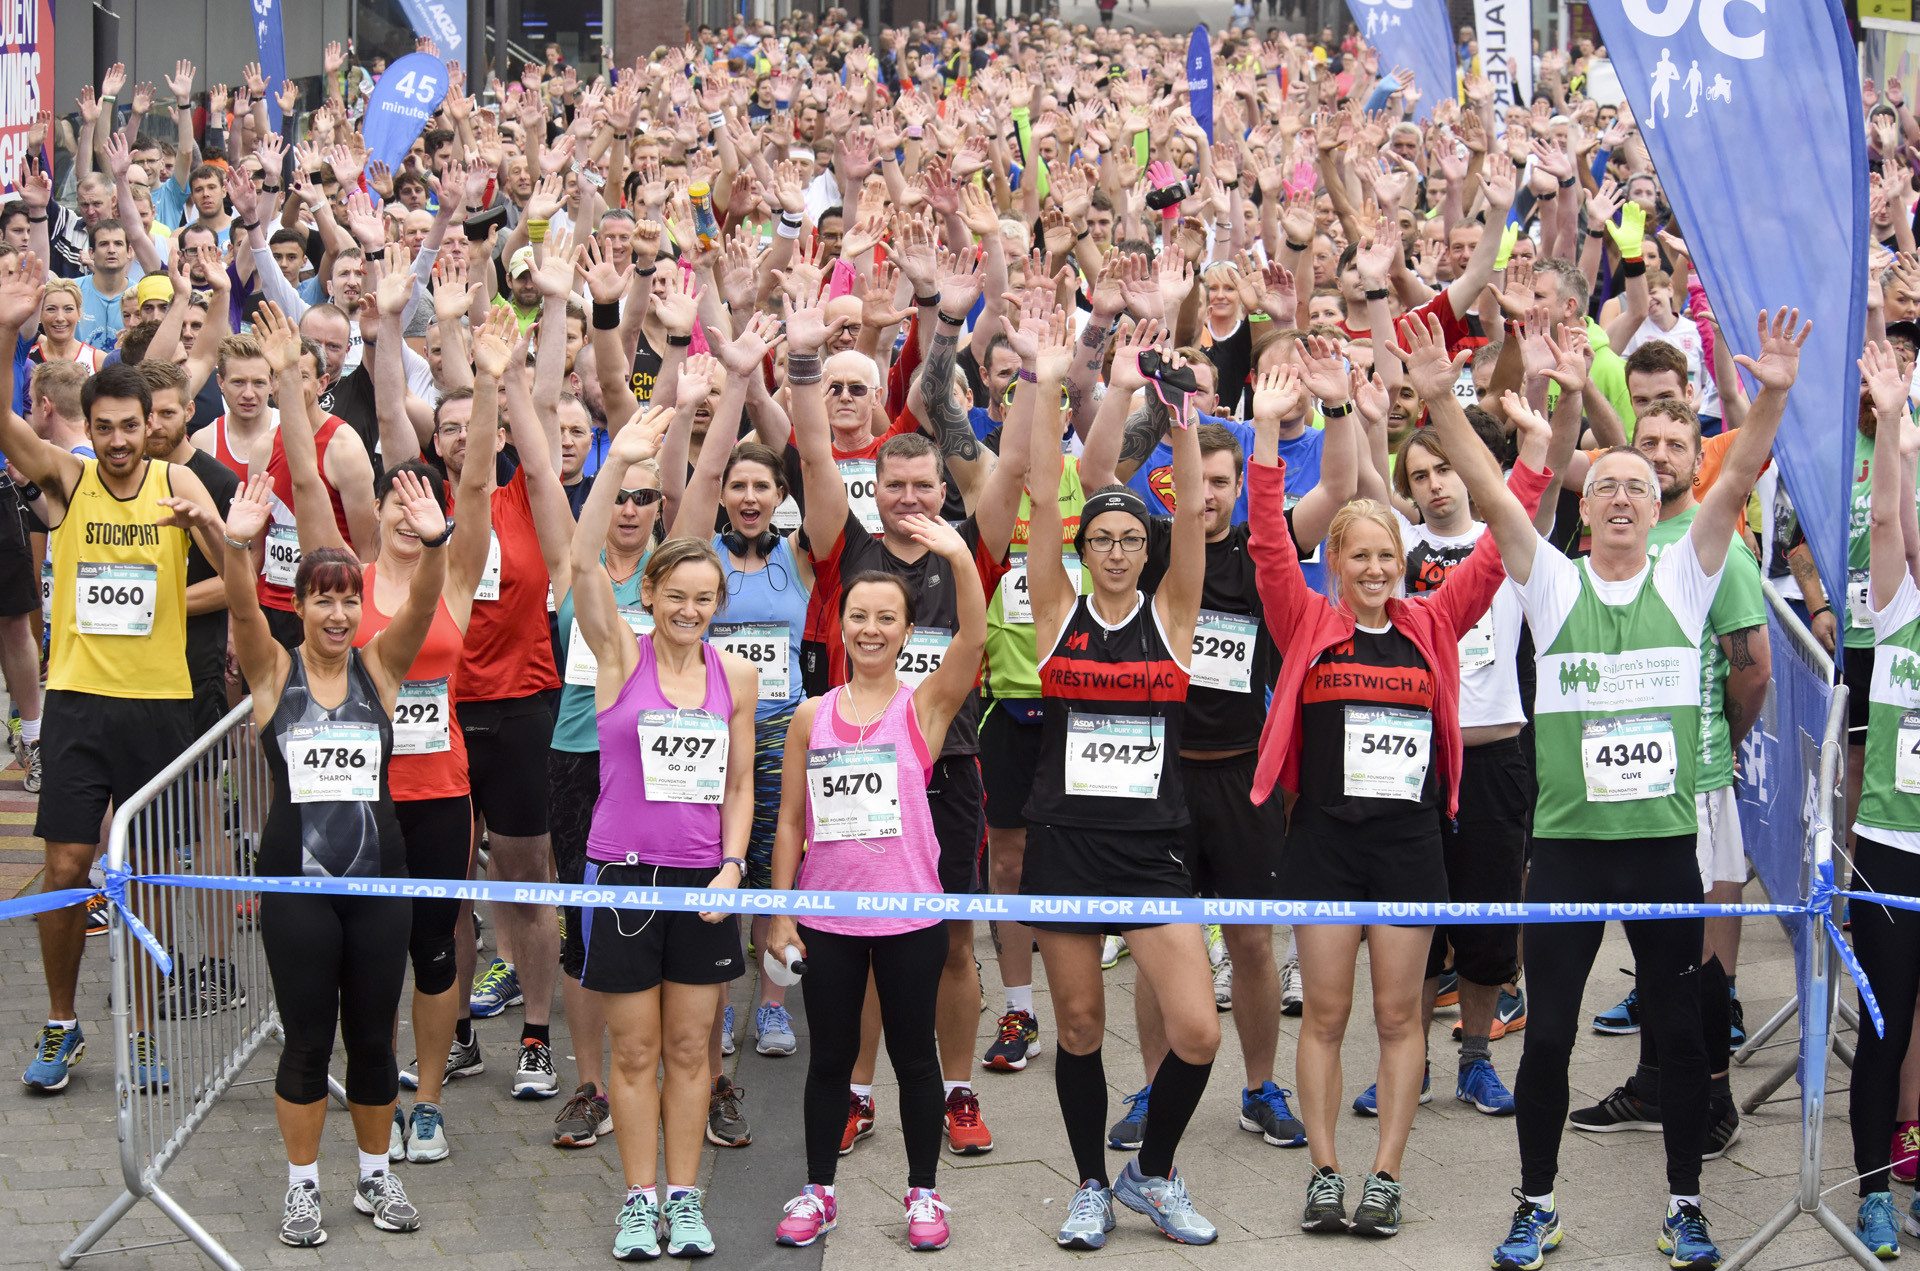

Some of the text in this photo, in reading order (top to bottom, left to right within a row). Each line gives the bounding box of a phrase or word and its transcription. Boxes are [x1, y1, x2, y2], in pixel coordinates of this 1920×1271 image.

[395, 70, 437, 103] 45
[382, 100, 429, 121] minutes
[1452, 384, 1474, 396] 25
[270, 544, 302, 564] 4082
[87, 586, 144, 605] 5060
[1192, 635, 1246, 662] 5298
[895, 652, 940, 674] 255
[1646, 658, 1680, 670] hospice
[1050, 668, 1174, 690] PRESTWICH AC
[1315, 673, 1412, 692] PRESTWICH
[1603, 675, 1680, 693] SOUTH WEST
[395, 703, 440, 724] 292
[1074, 720, 1094, 728] ASDA
[652, 736, 716, 758] 4797
[1082, 742, 1151, 764] 4947
[1361, 734, 1418, 758] 5476
[1596, 742, 1662, 766] 4340
[303, 748, 366, 768] 4786
[822, 772, 882, 798] 5470
[1622, 772, 1642, 780] CLIVE
[454, 886, 492, 900] ALL
[514, 888, 663, 905] RUN FOR ALL
[684, 892, 836, 910] RUN FOR ALL
[856, 896, 1009, 913] RUN FOR ALL
[1030, 899, 1182, 916] RUN FOR ALL
[1204, 901, 1356, 917] RUN FOR ALL
[1377, 902, 1528, 917] RUN FOR ALL
[1550, 903, 1700, 916] RUN FOR ALL
